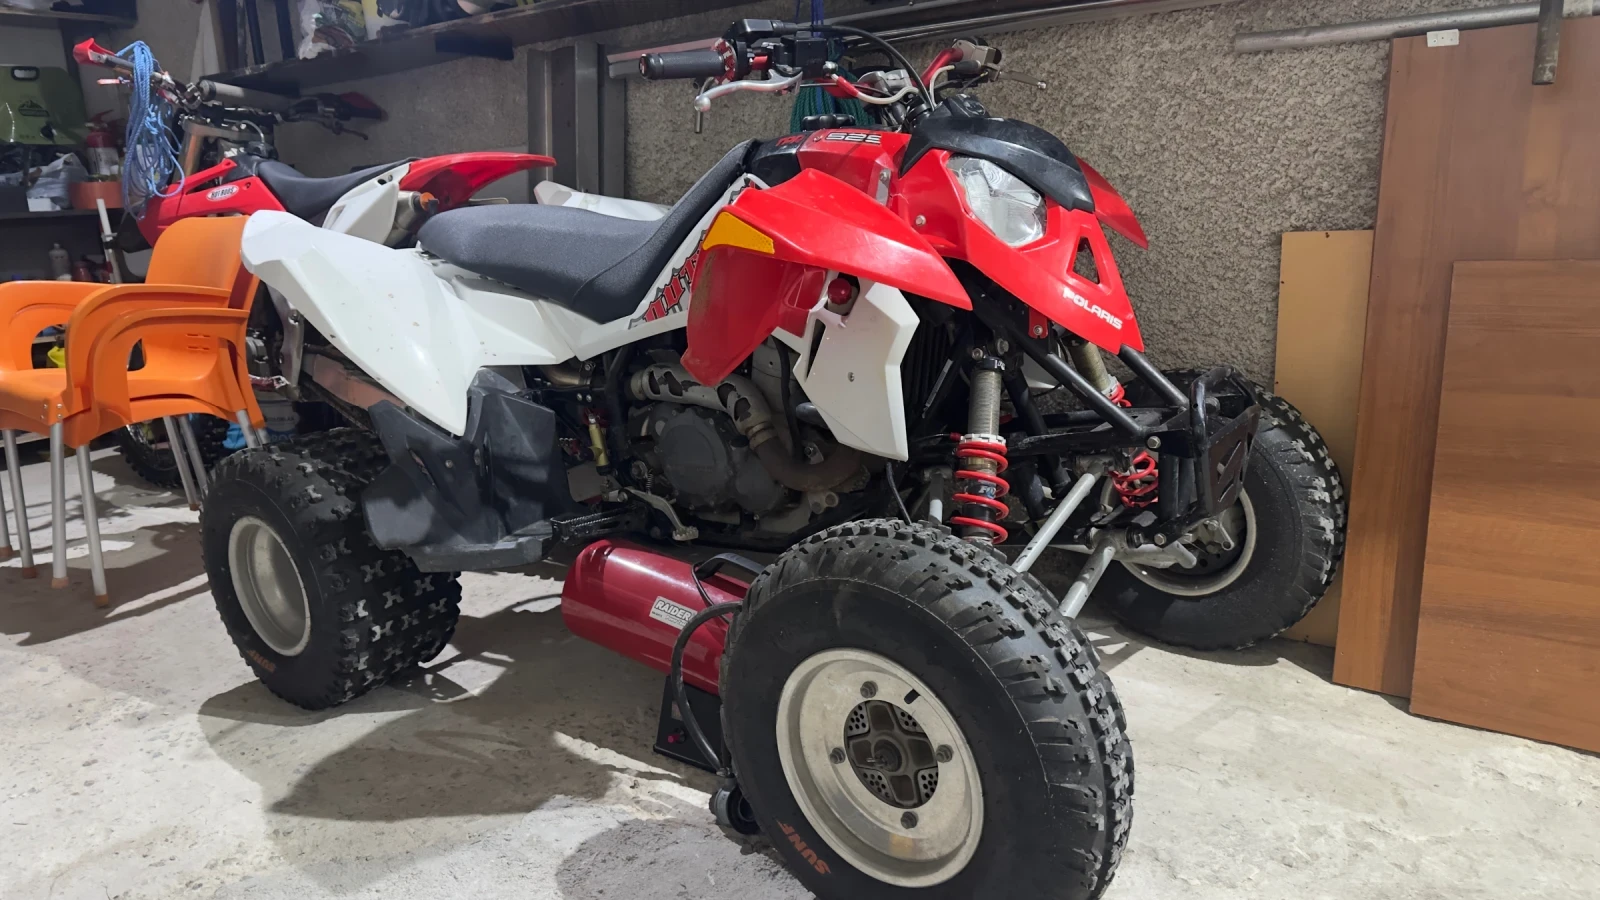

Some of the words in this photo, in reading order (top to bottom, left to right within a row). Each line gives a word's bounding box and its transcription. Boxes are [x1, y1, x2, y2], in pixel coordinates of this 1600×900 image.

[1063, 287, 1123, 330] POLARIS
[654, 599, 692, 621] RAIDER
[776, 820, 831, 874] SUNF
